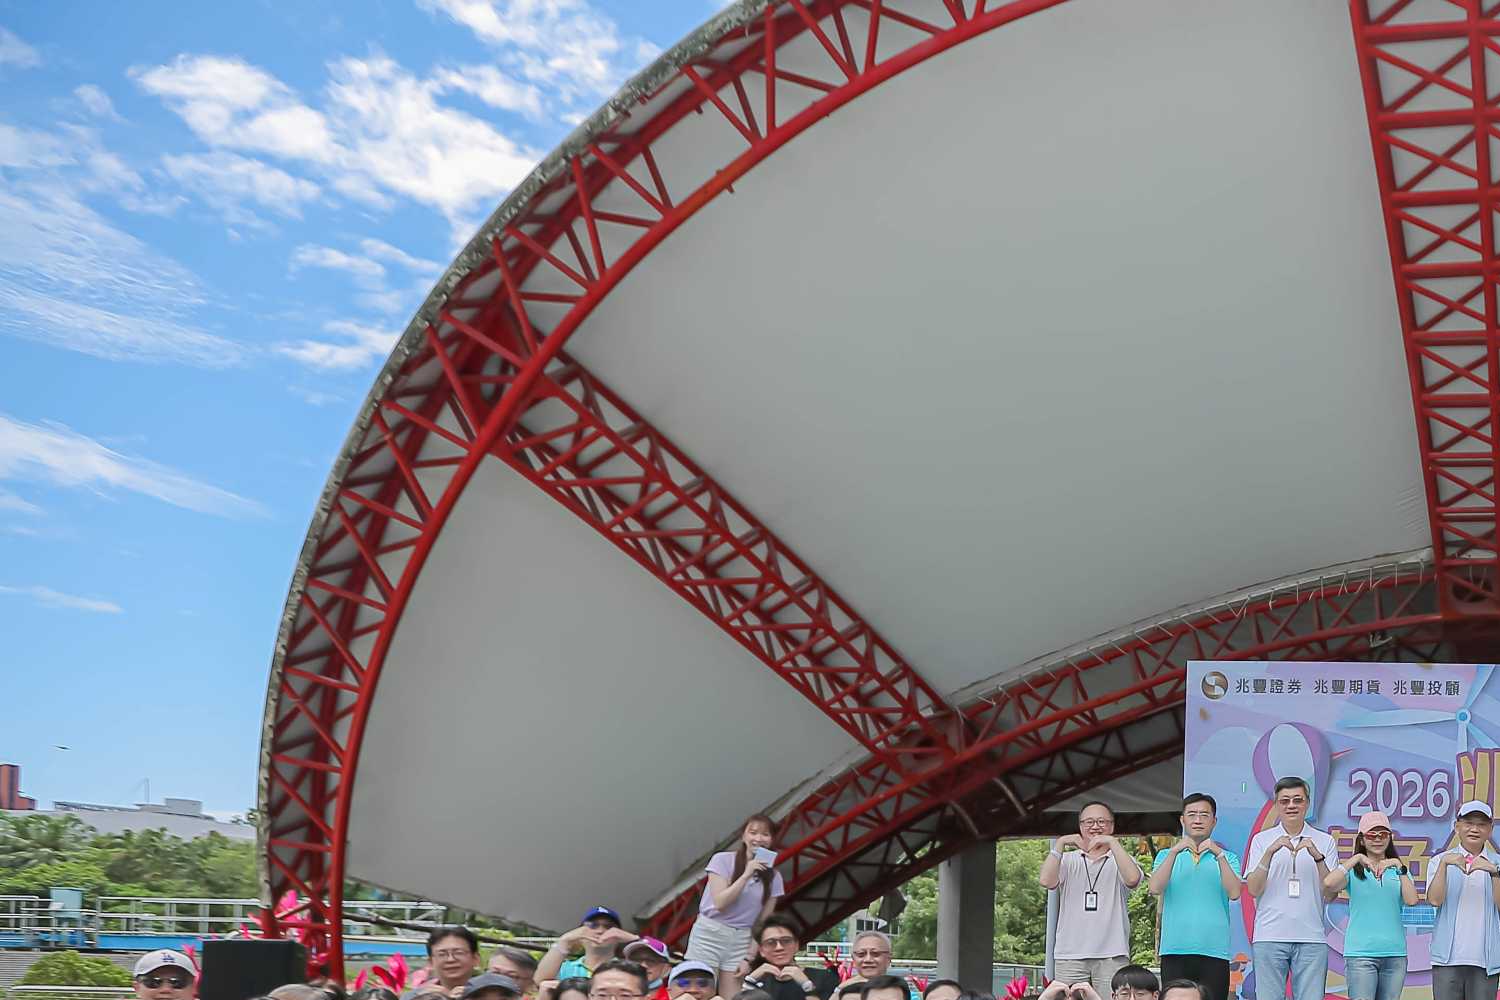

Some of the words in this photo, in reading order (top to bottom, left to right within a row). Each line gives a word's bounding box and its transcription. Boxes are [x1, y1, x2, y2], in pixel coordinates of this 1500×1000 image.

[1235, 678, 1303, 695] 兆豐證券
[1313, 679, 1382, 696] 兆豐期貨
[1392, 680, 1462, 697] 兆豐投顧
[1349, 770, 1450, 818] 2026
